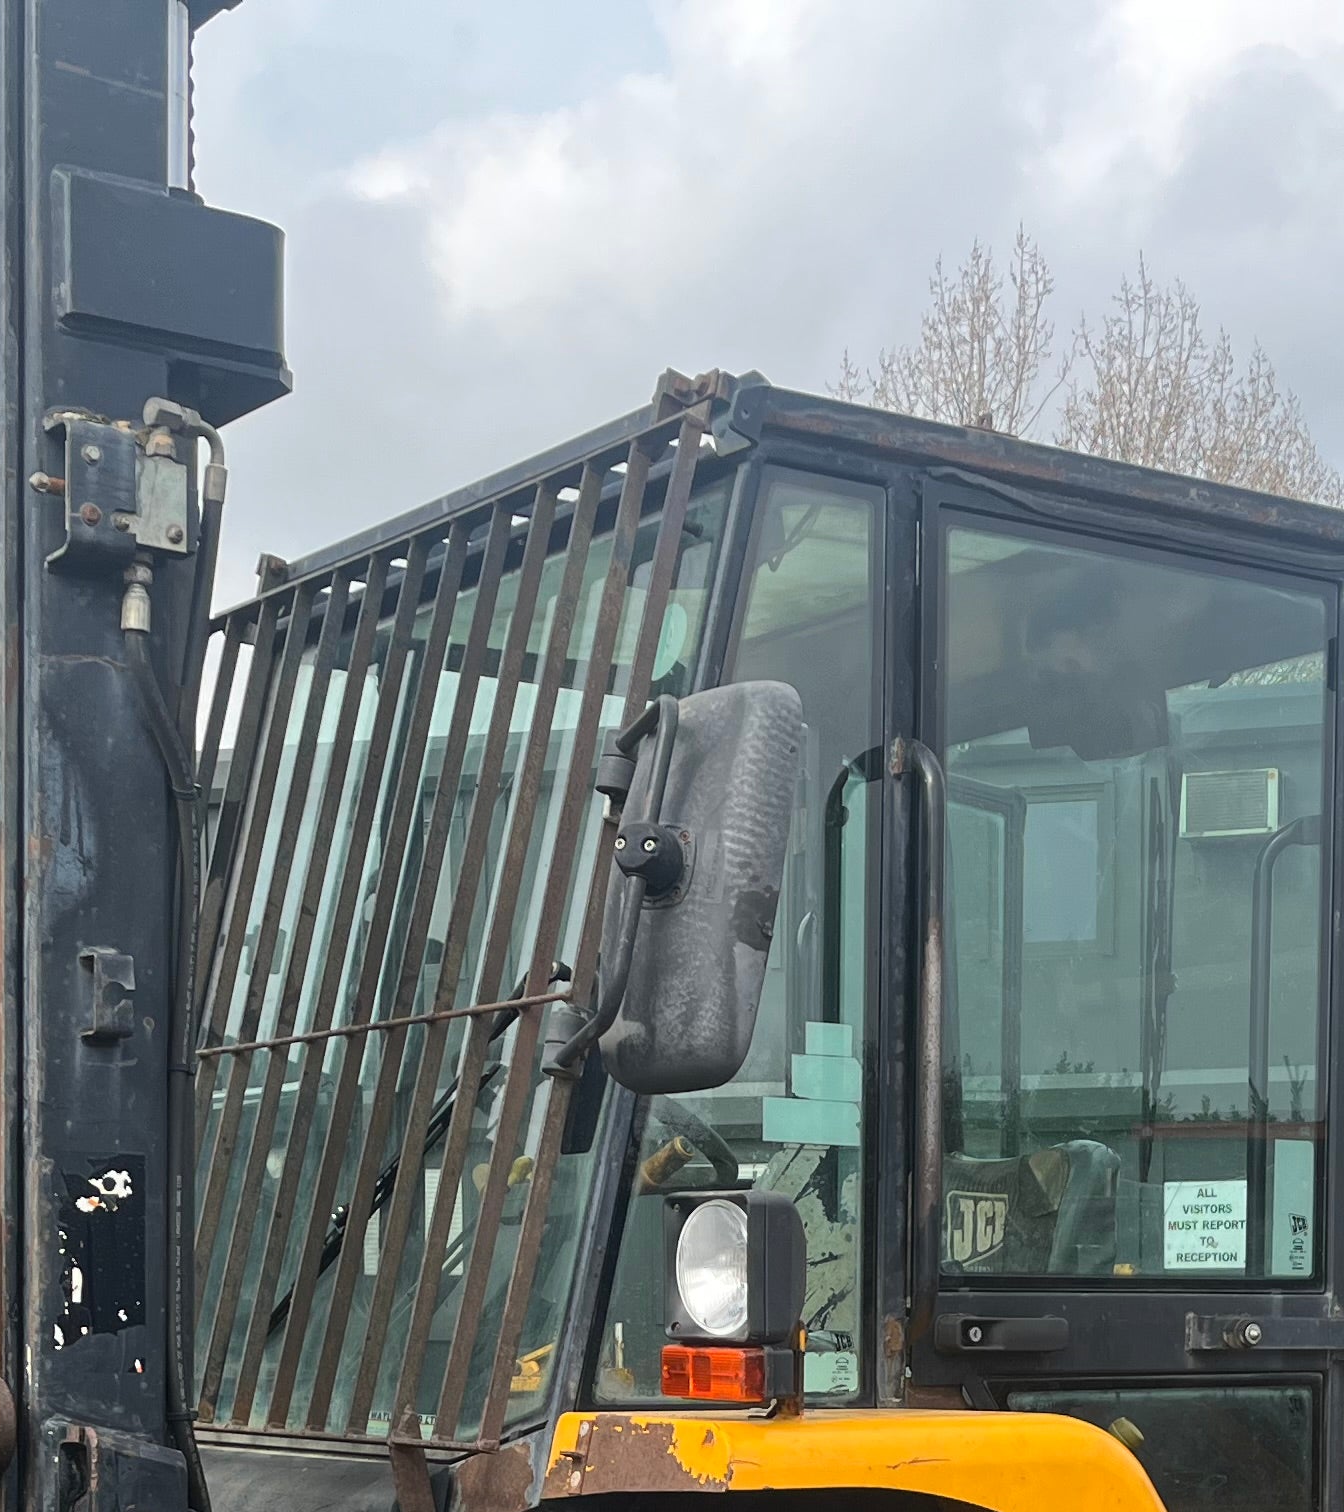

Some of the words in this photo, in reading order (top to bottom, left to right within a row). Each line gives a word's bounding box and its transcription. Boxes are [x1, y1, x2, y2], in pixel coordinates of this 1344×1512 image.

[1197, 1188, 1217, 1198] ALL
[1183, 1204, 1232, 1214] VISITORS
[953, 1199, 1006, 1260] JCB
[1168, 1220, 1197, 1231] MUST
[1202, 1219, 1246, 1230] REPORT
[1200, 1236, 1215, 1247] TO
[1176, 1252, 1238, 1262] RECEPTION
[835, 1333, 853, 1351] JCB
